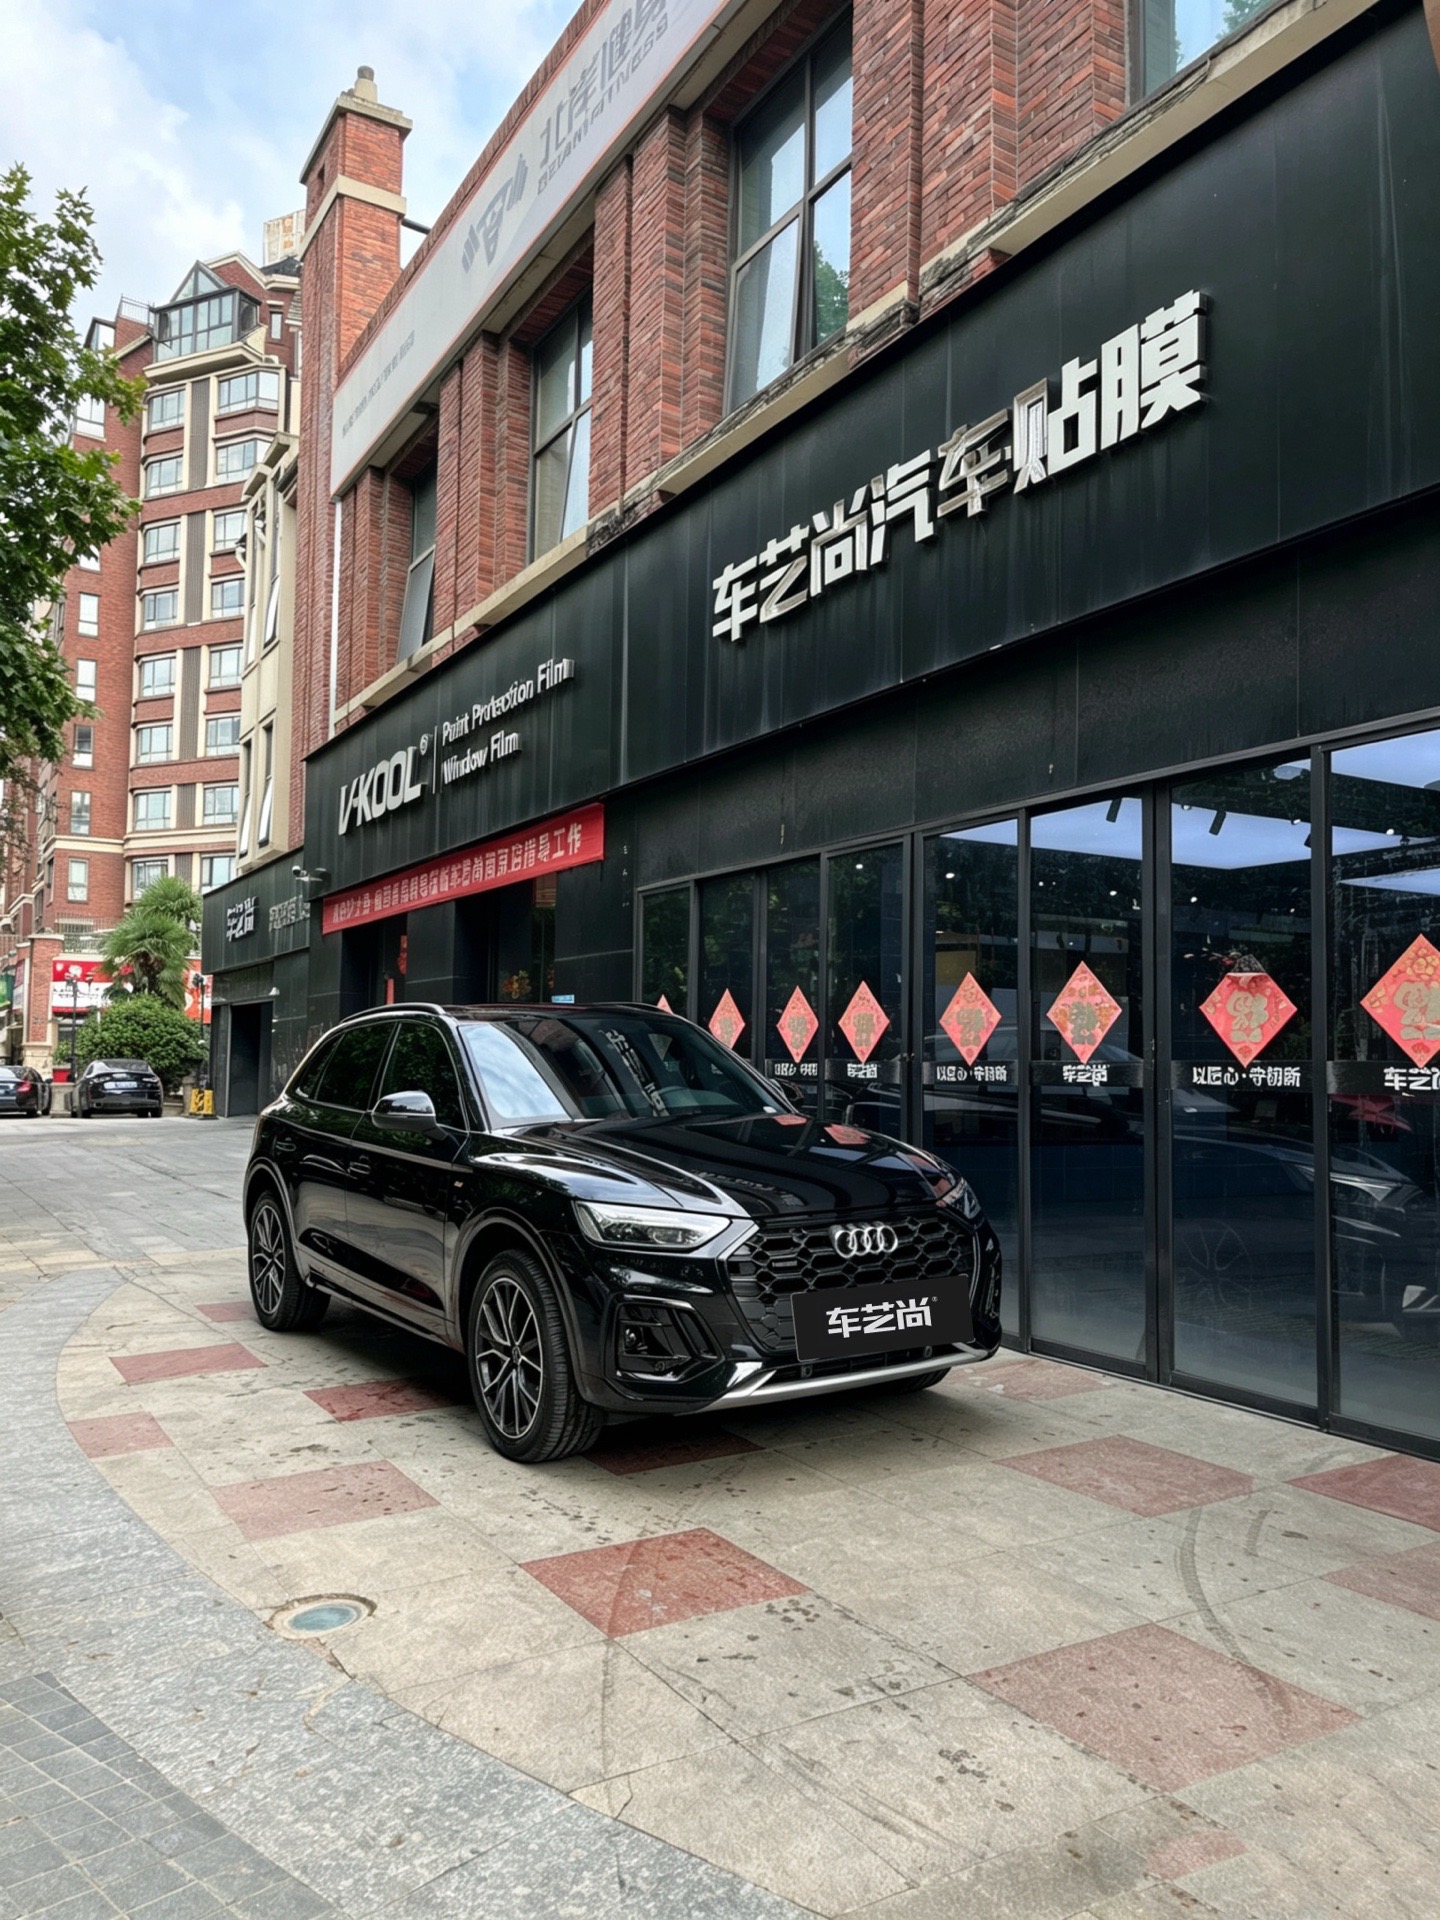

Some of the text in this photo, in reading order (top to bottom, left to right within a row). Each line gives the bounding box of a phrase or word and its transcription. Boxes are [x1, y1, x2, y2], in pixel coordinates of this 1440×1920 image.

[712, 289, 1205, 642] 车艺尚汽车贴膜
[537, 658, 574, 694] Film
[441, 729, 520, 785] Window Film
[338, 746, 423, 836] V-KOOL
[825, 1296, 933, 1339] 车艺尚
